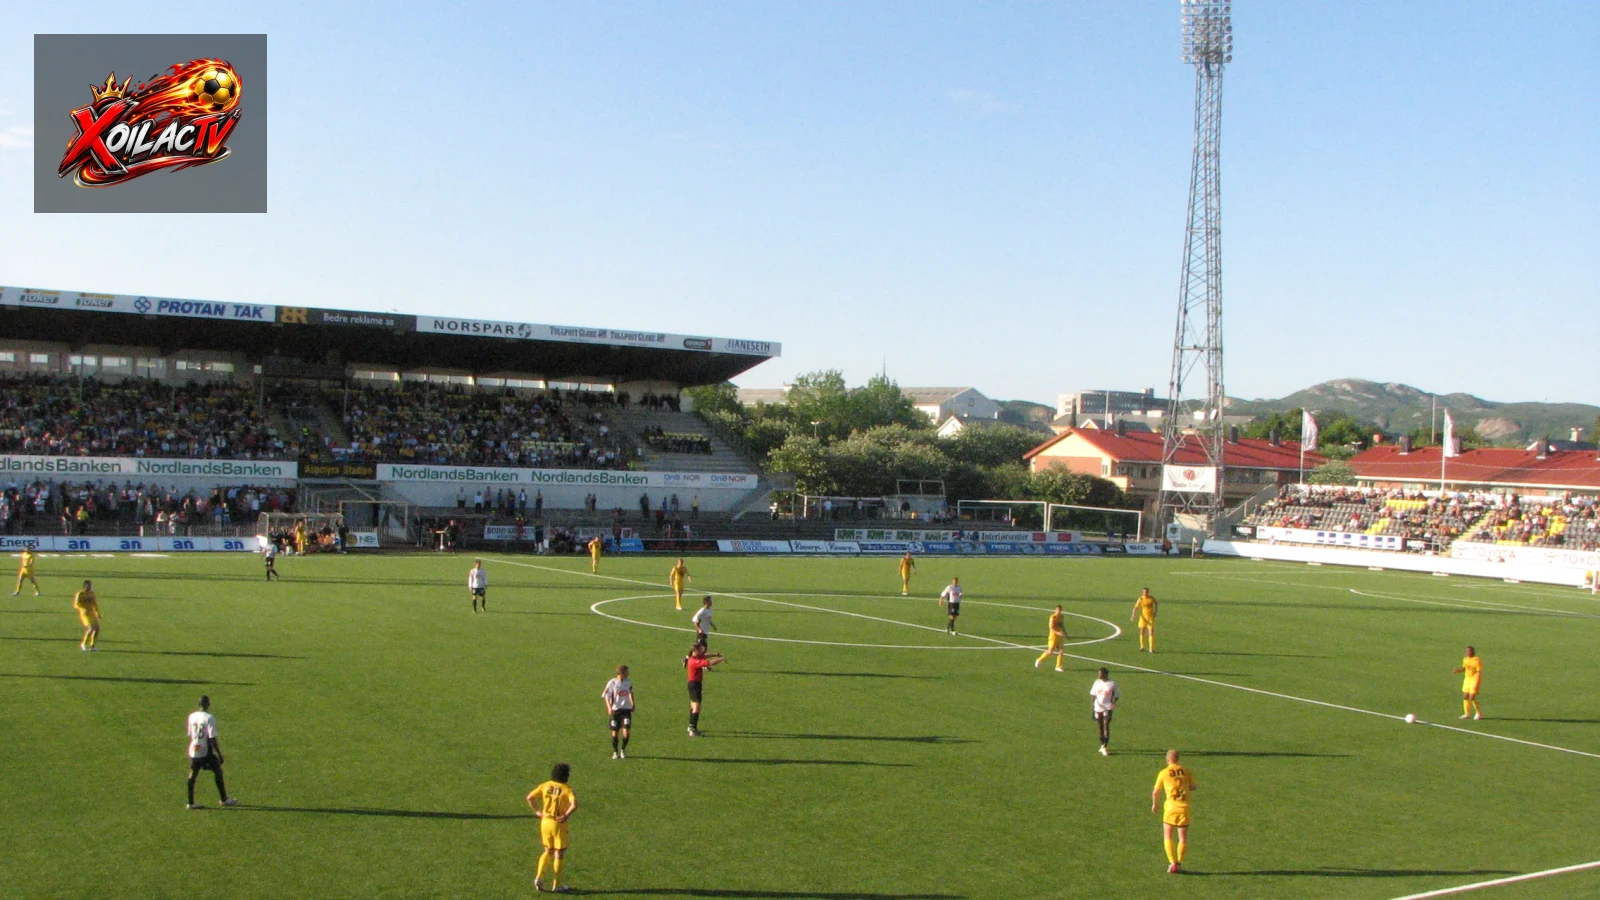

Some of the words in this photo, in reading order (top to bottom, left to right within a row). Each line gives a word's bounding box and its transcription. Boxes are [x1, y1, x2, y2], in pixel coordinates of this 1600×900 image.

[157, 299, 226, 317] PROTAN
[233, 304, 266, 319] TAK
[323, 312, 348, 323] Bedre
[350, 314, 384, 326] reklame
[433, 319, 515, 335] NORSPAR
[137, 461, 282, 476] NordlandsBanken
[391, 466, 519, 481] NordlandsBanken
[531, 471, 649, 485] NordlandsBanken
[0, 537, 40, 550] Energi
[68, 539, 91, 550] an
[120, 539, 142, 550] an
[173, 540, 194, 550] an
[224, 540, 245, 550] an
[545, 795, 560, 816] 21
